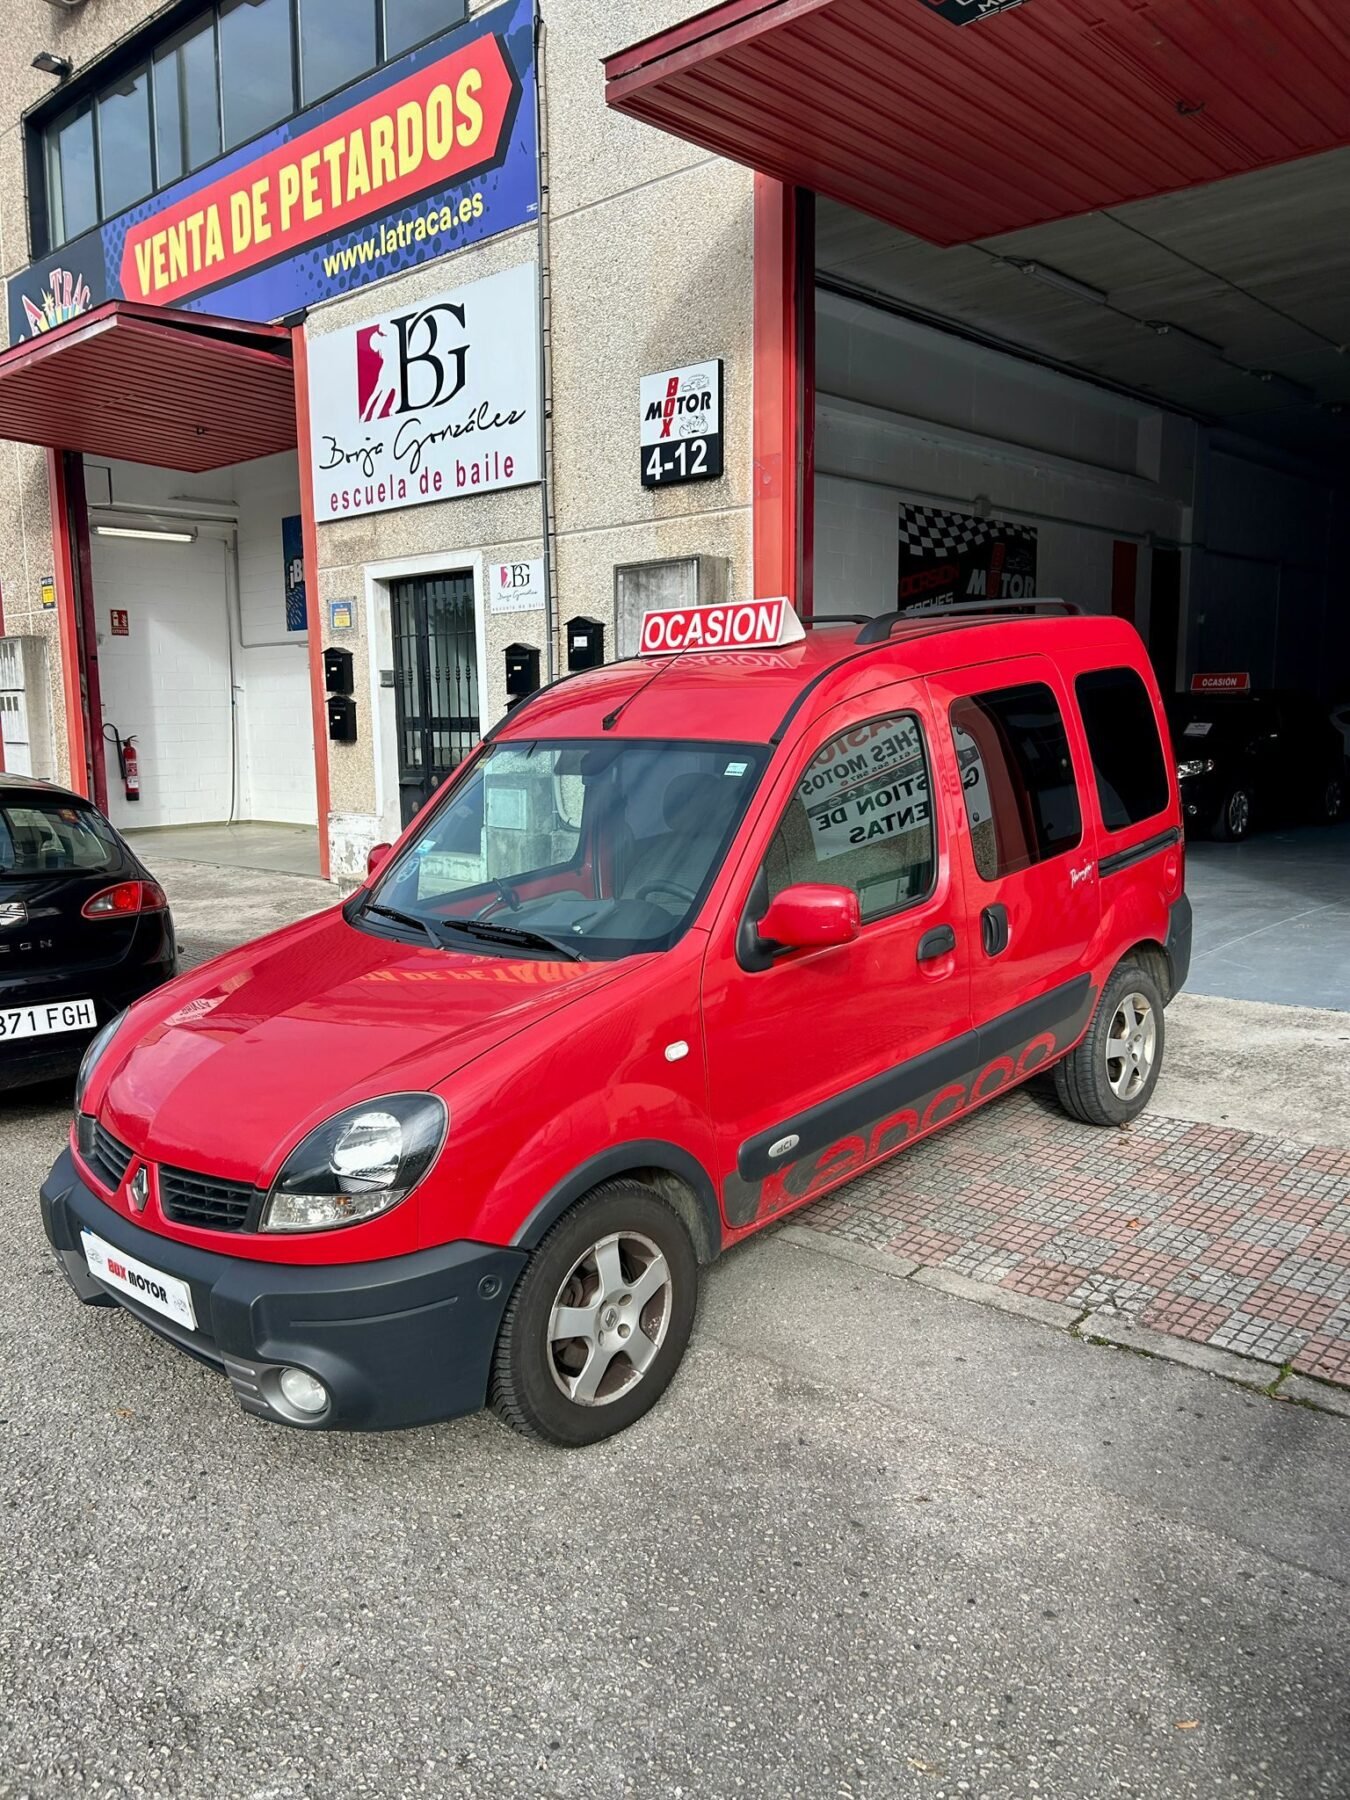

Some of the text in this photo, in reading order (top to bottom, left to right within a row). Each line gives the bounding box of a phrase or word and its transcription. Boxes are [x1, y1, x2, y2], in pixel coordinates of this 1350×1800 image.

[134, 67, 484, 297] VENTA DE PETARDOS
[323, 192, 484, 277] www.latraca.es
[390, 303, 470, 415] BG
[644, 391, 712, 421] MOTOR
[660, 377, 679, 438] BOX
[319, 401, 527, 477] Borja González
[646, 439, 708, 480] 4-12
[330, 451, 514, 512] escuela de baile
[644, 604, 779, 649] OCASION
[46, 1003, 91, 1029] FGH
[107, 1258, 169, 1304] BOX MOTOR
